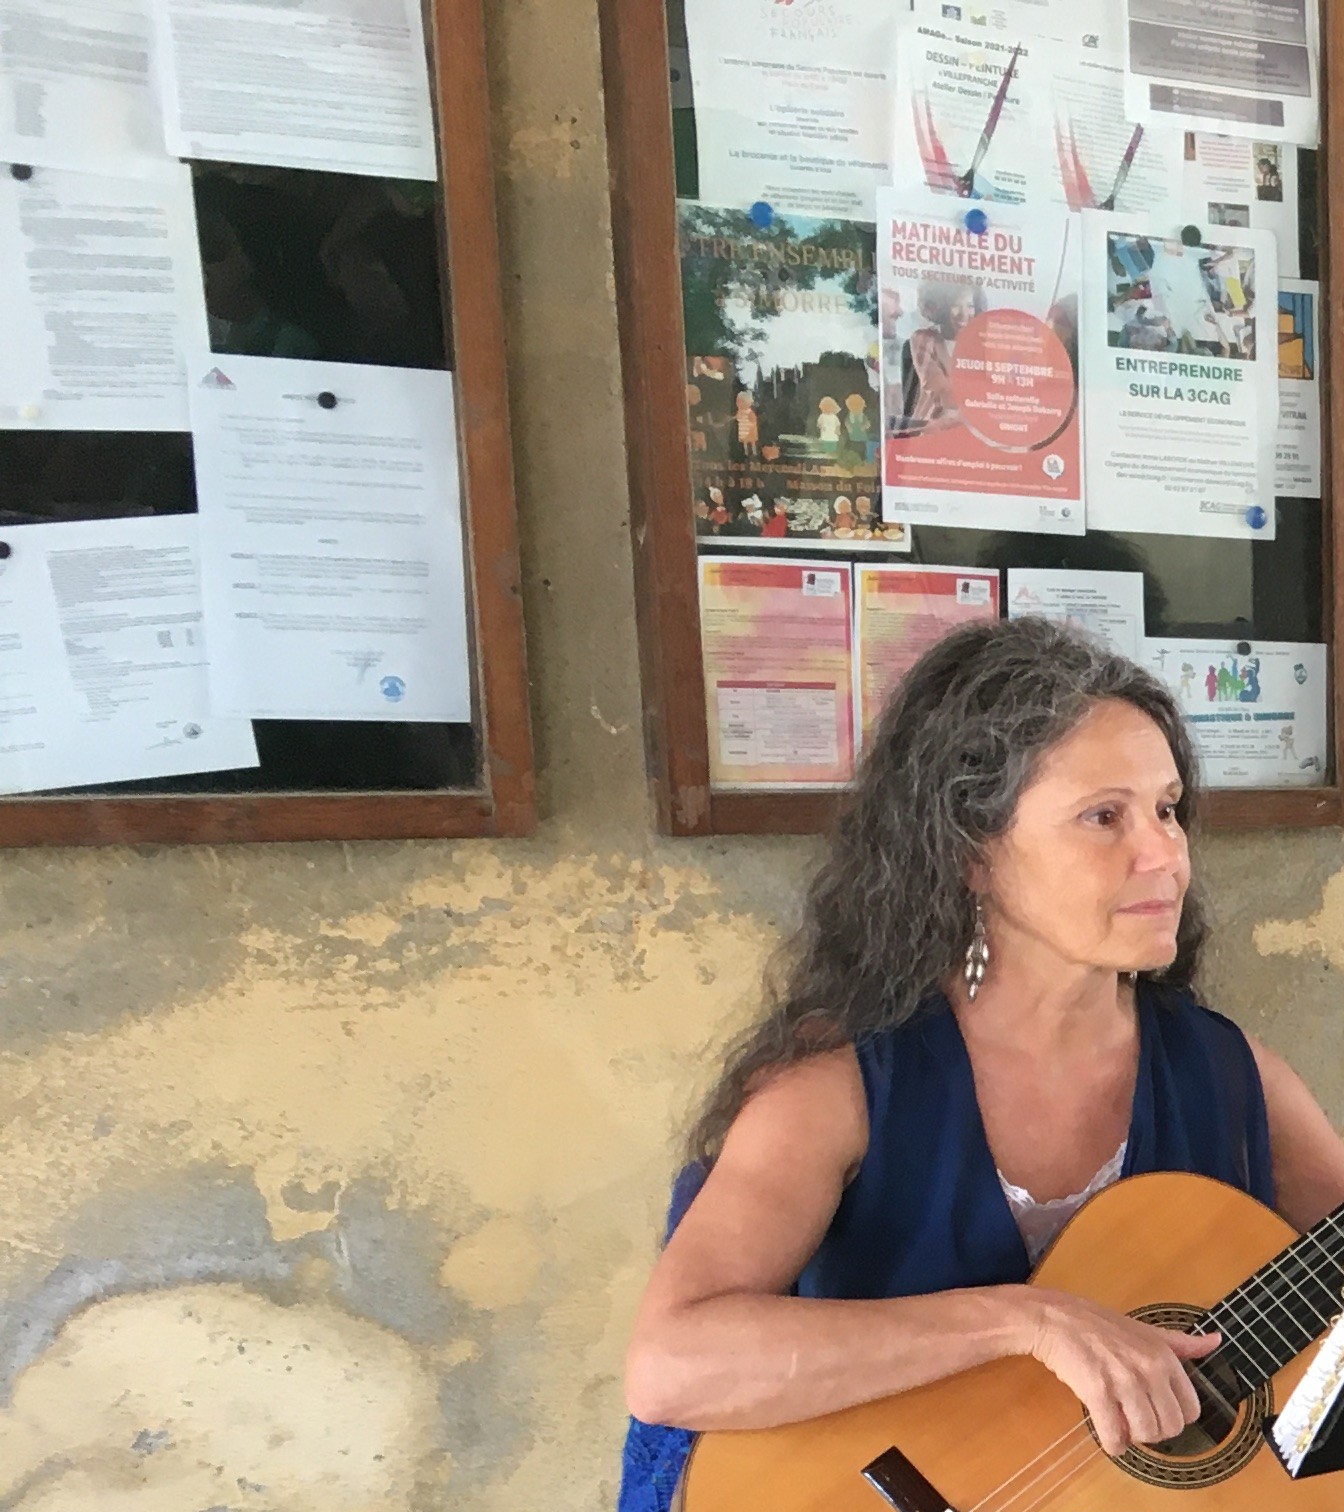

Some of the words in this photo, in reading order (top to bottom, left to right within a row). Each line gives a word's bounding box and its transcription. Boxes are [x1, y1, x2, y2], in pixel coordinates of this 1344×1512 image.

[926, 50, 959, 67] DESSIN
[892, 219, 989, 250] MATINALE
[994, 232, 1022, 254] DU
[892, 242, 1035, 276] RECRUTEMENT
[892, 266, 919, 279] TOUS
[921, 269, 973, 285] SECTEURS
[956, 359, 984, 371] JEUDI
[986, 360, 993, 371] 8
[995, 361, 1053, 377] SEPTEMBRE
[1116, 357, 1243, 382] ENTREPRENDRE
[1129, 383, 1160, 399] SUR
[1164, 387, 1184, 401] LA
[1188, 389, 1231, 405] 3CAG
